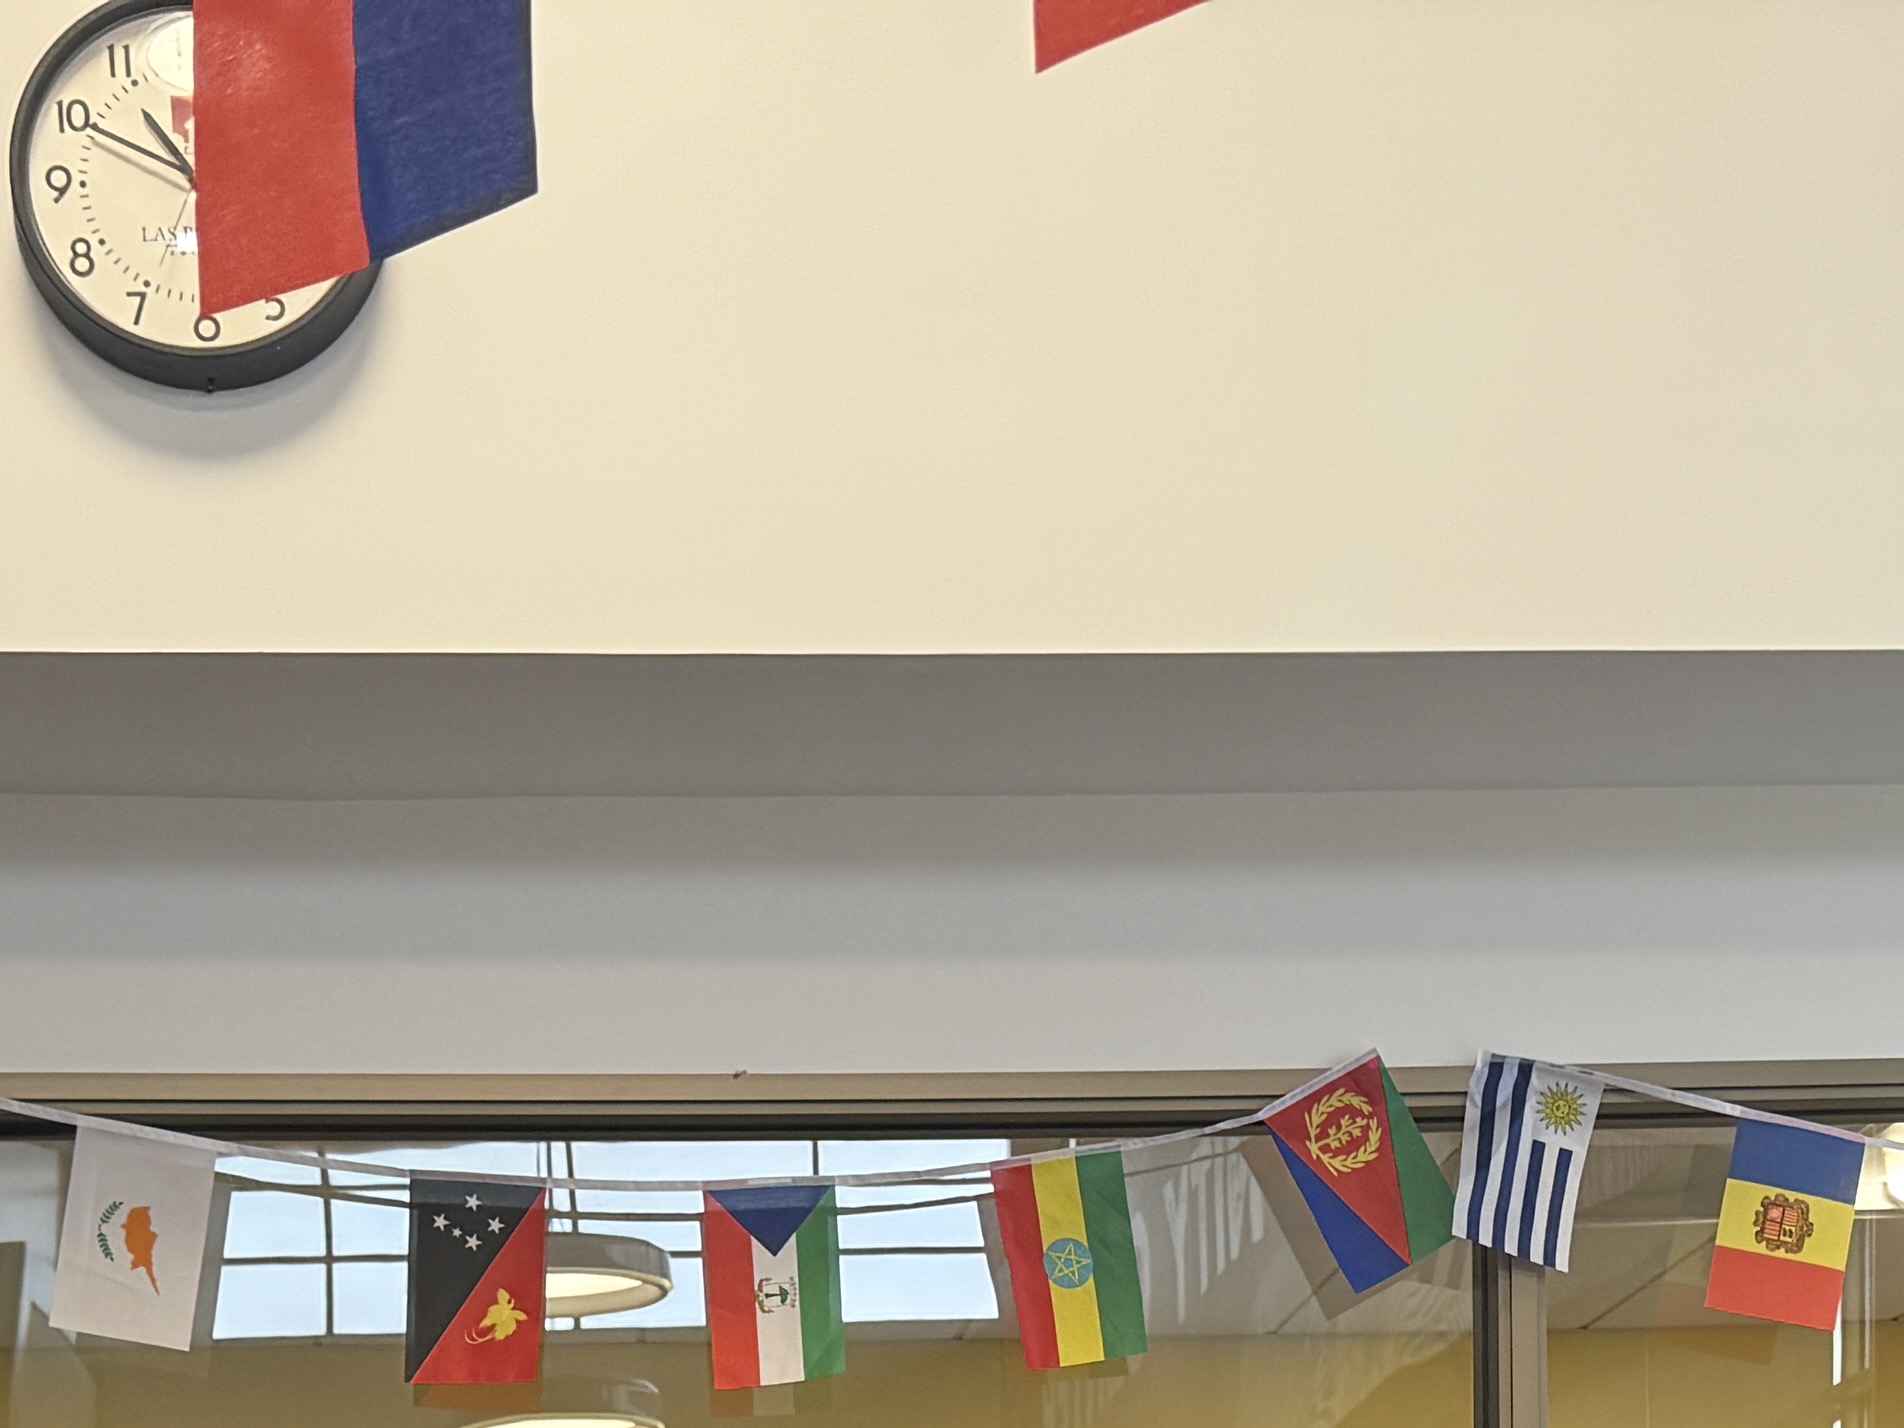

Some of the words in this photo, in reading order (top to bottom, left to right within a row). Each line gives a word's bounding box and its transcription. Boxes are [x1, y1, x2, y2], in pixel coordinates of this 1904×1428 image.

[107, 43, 132, 79] 11
[55, 98, 91, 134] 10
[45, 165, 73, 204] 9
[69, 237, 95, 278] 8
[125, 291, 147, 326] 7
